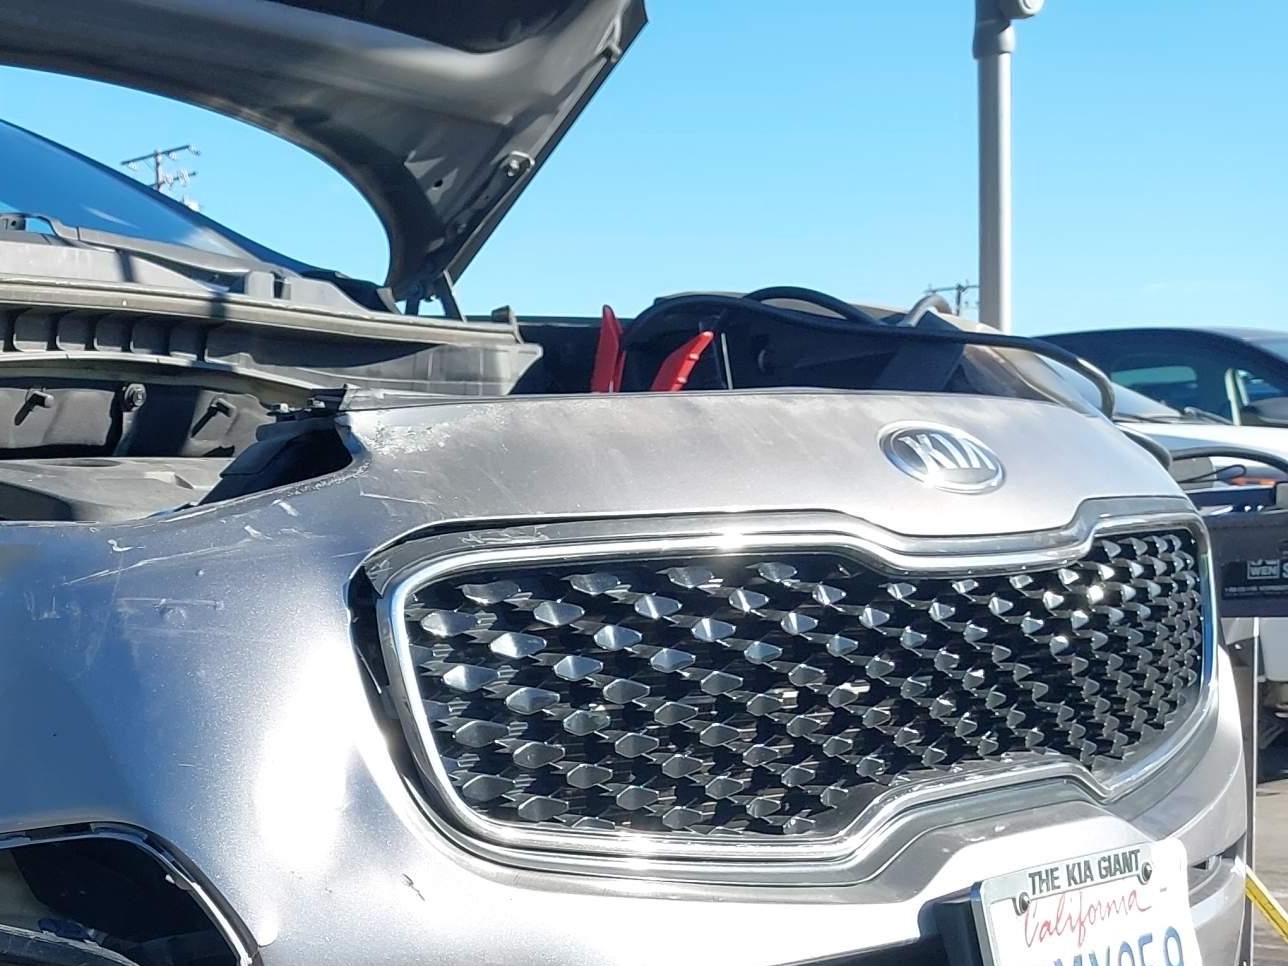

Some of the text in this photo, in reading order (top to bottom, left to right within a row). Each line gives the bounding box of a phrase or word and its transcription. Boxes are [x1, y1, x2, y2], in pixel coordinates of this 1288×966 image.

[1028, 849, 1142, 896] THE KIA GIANT
[1023, 889, 1152, 948] California
